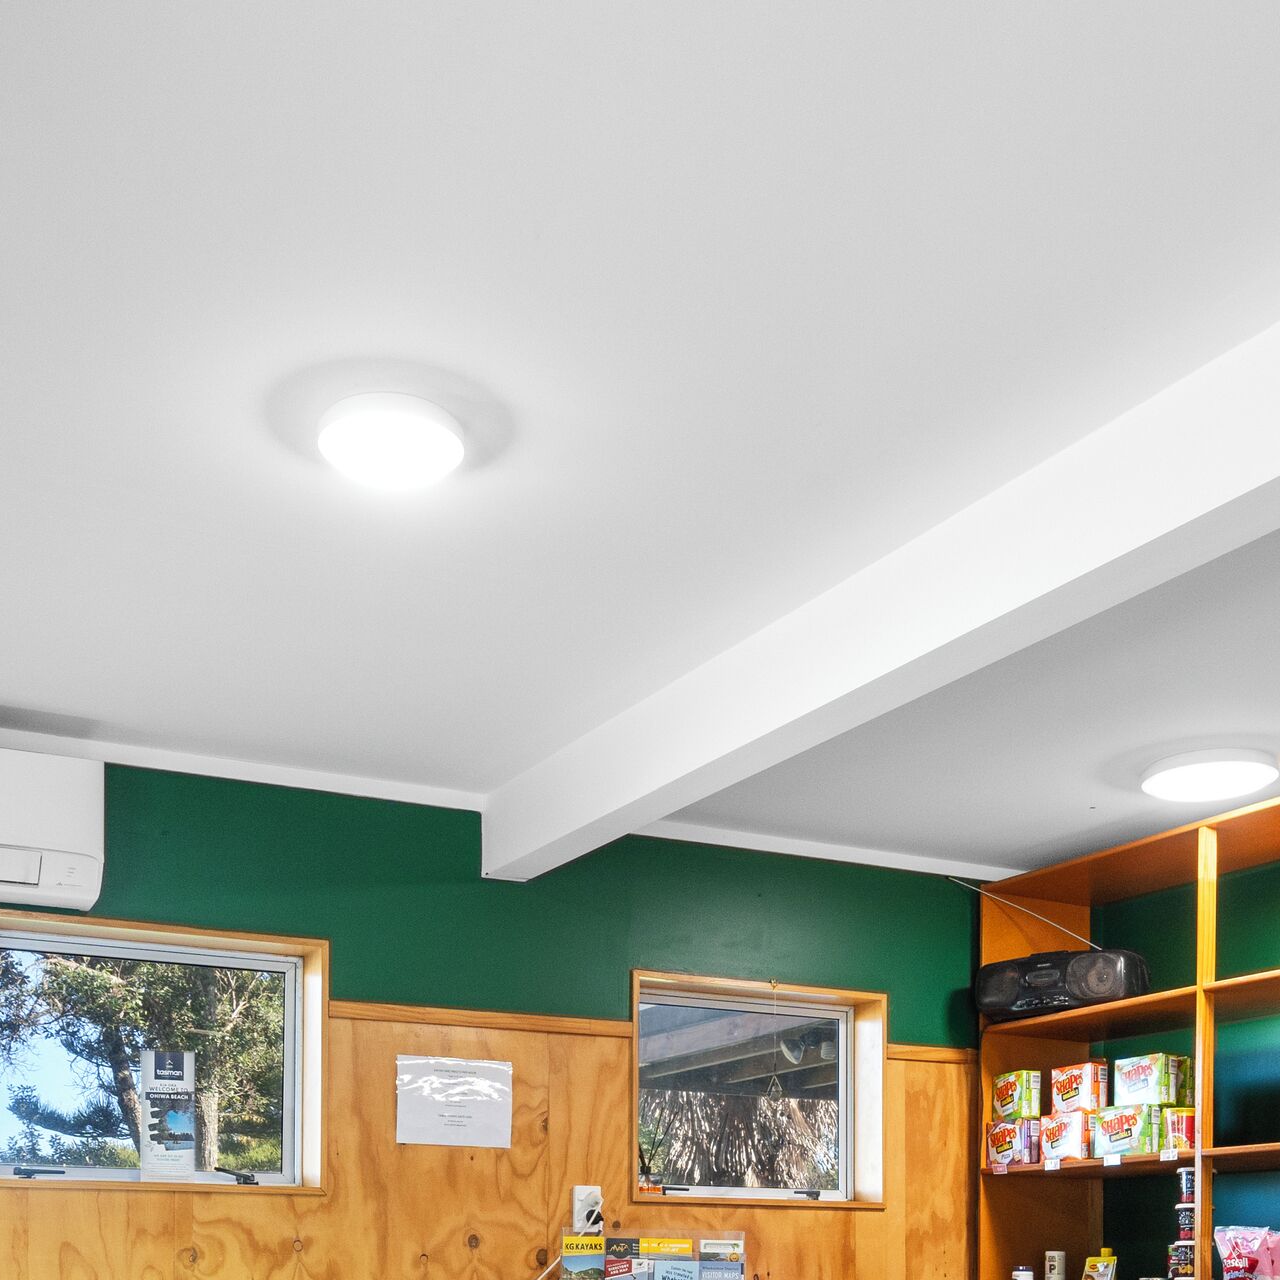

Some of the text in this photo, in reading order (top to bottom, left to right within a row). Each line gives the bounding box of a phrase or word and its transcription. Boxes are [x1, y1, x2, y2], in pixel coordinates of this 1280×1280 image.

[156, 1069, 183, 1077] tasman
[1055, 1073, 1083, 1095] Shapes
[1101, 1113, 1138, 1136] Shapes
[990, 1126, 1017, 1148] Shapes
[576, 1242, 603, 1251] KAYAKS
[701, 1271, 740, 1280] VISITOR MAPS
